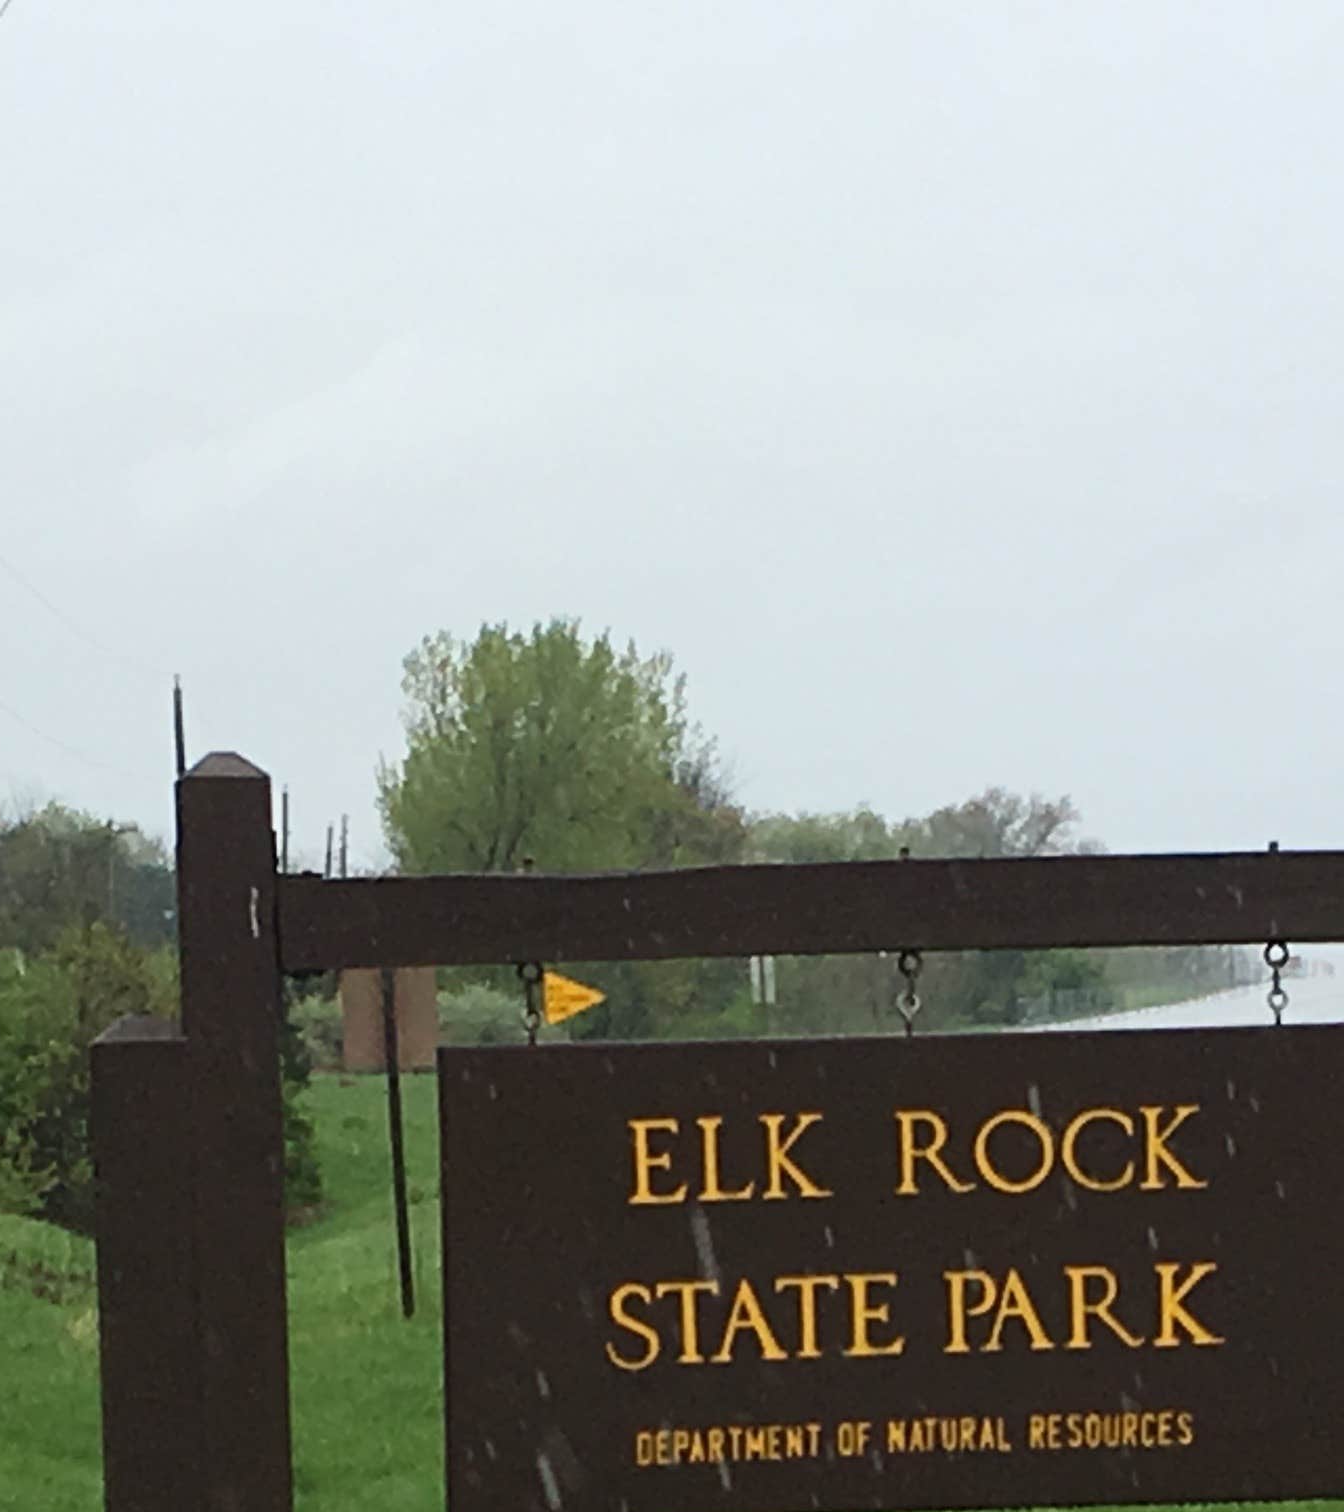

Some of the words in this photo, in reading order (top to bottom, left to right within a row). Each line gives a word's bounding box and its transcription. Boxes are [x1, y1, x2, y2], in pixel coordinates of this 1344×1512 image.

[627, 1111, 831, 1205] ELK
[895, 1104, 1207, 1196] ROCK
[607, 1271, 904, 1371] STATE
[944, 1260, 1224, 1355] PARK
[635, 1423, 821, 1467] DEPARTMENT
[836, 1421, 870, 1457] OF
[885, 1416, 1011, 1453] NATURAL
[1028, 1411, 1194, 1449] RESOURCES
